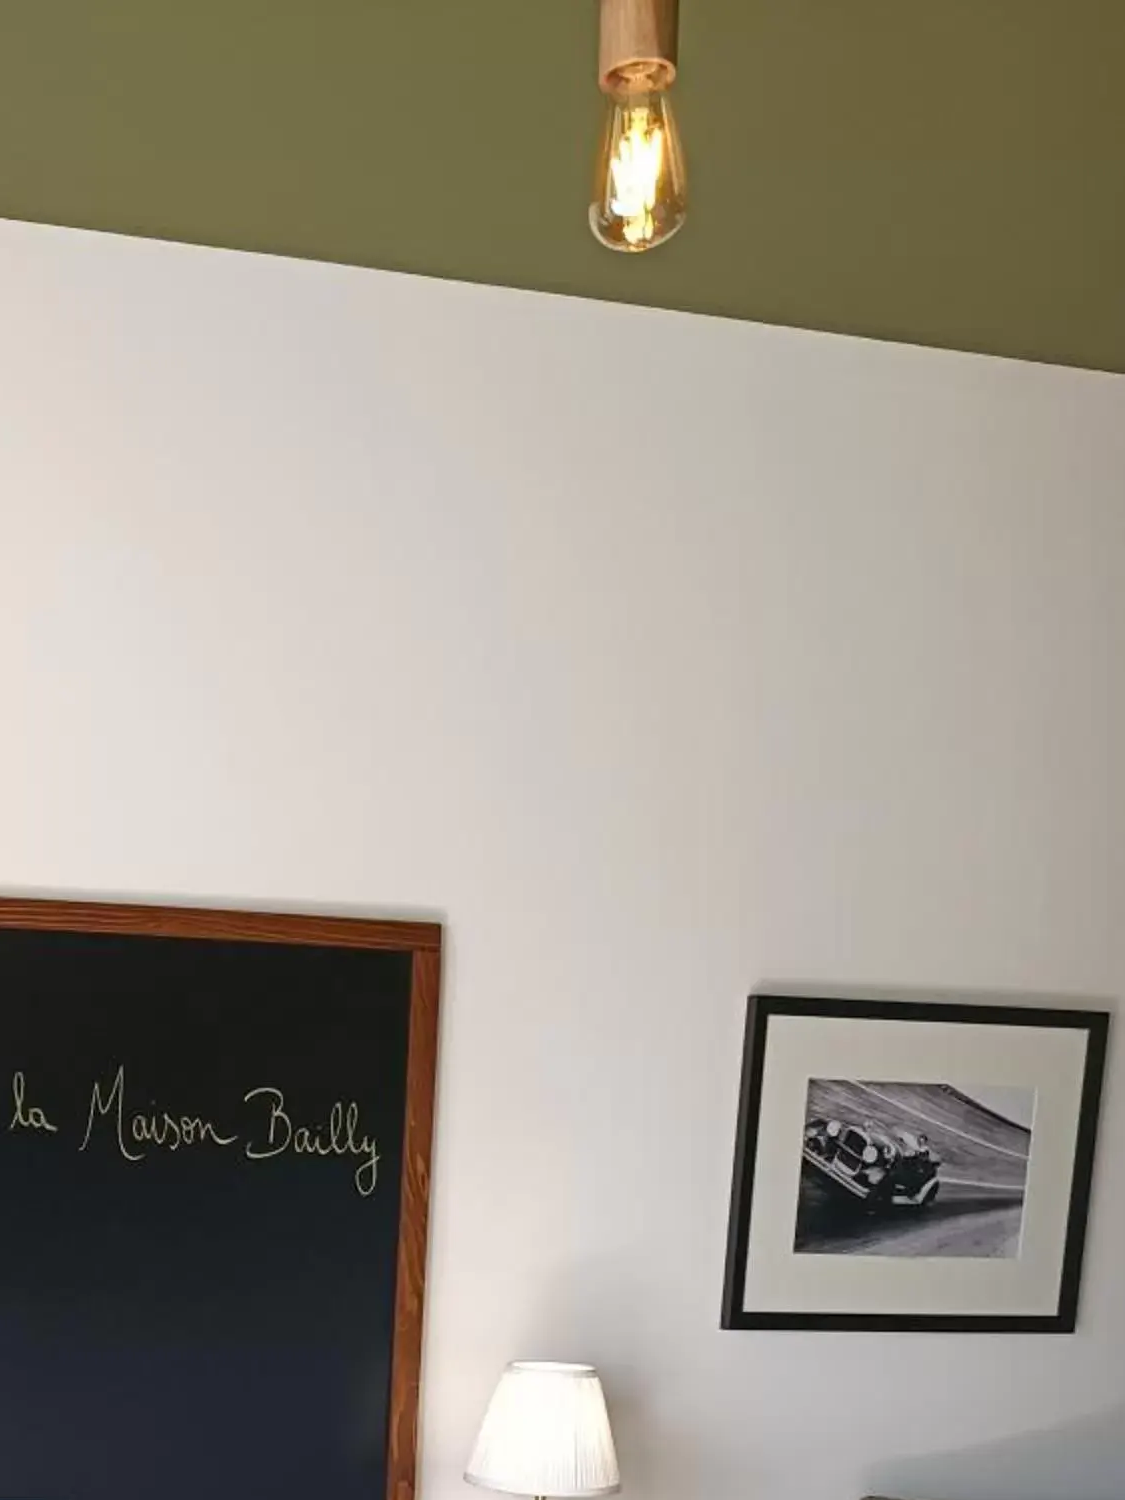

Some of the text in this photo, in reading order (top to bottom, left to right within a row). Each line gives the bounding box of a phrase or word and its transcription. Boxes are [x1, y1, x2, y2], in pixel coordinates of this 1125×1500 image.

[9, 1071, 59, 1132] la
[78, 1063, 239, 1161] Maison
[243, 1086, 380, 1197] Bailly
